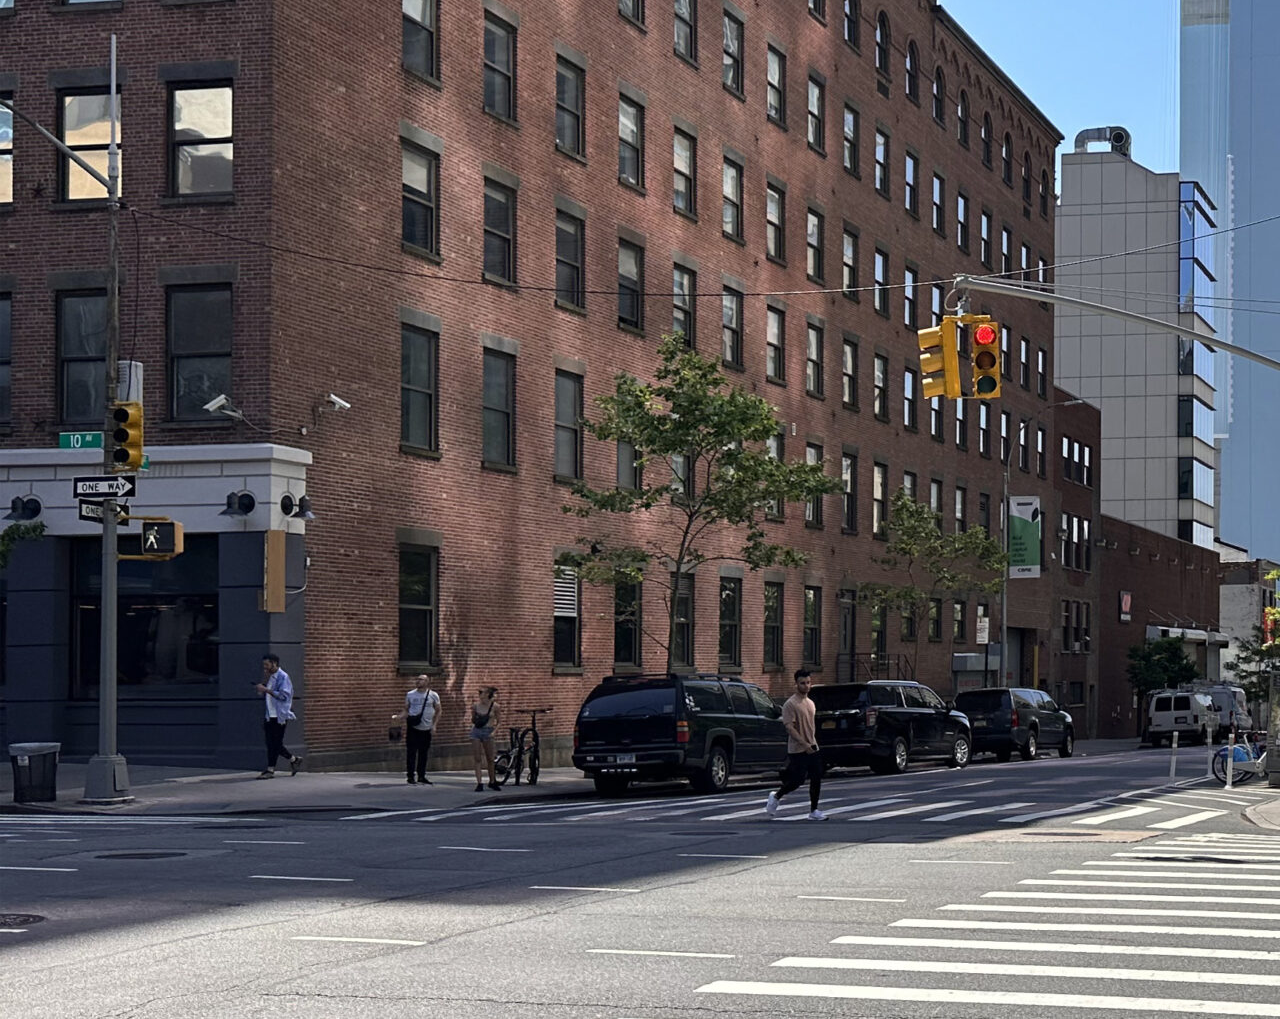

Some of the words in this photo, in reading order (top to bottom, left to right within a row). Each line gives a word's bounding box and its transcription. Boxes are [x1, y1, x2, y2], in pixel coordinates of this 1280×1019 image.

[70, 434, 81, 448] 10
[81, 483, 100, 492] ONE
[107, 482, 127, 492] WAY
[85, 506, 100, 516] ONE
